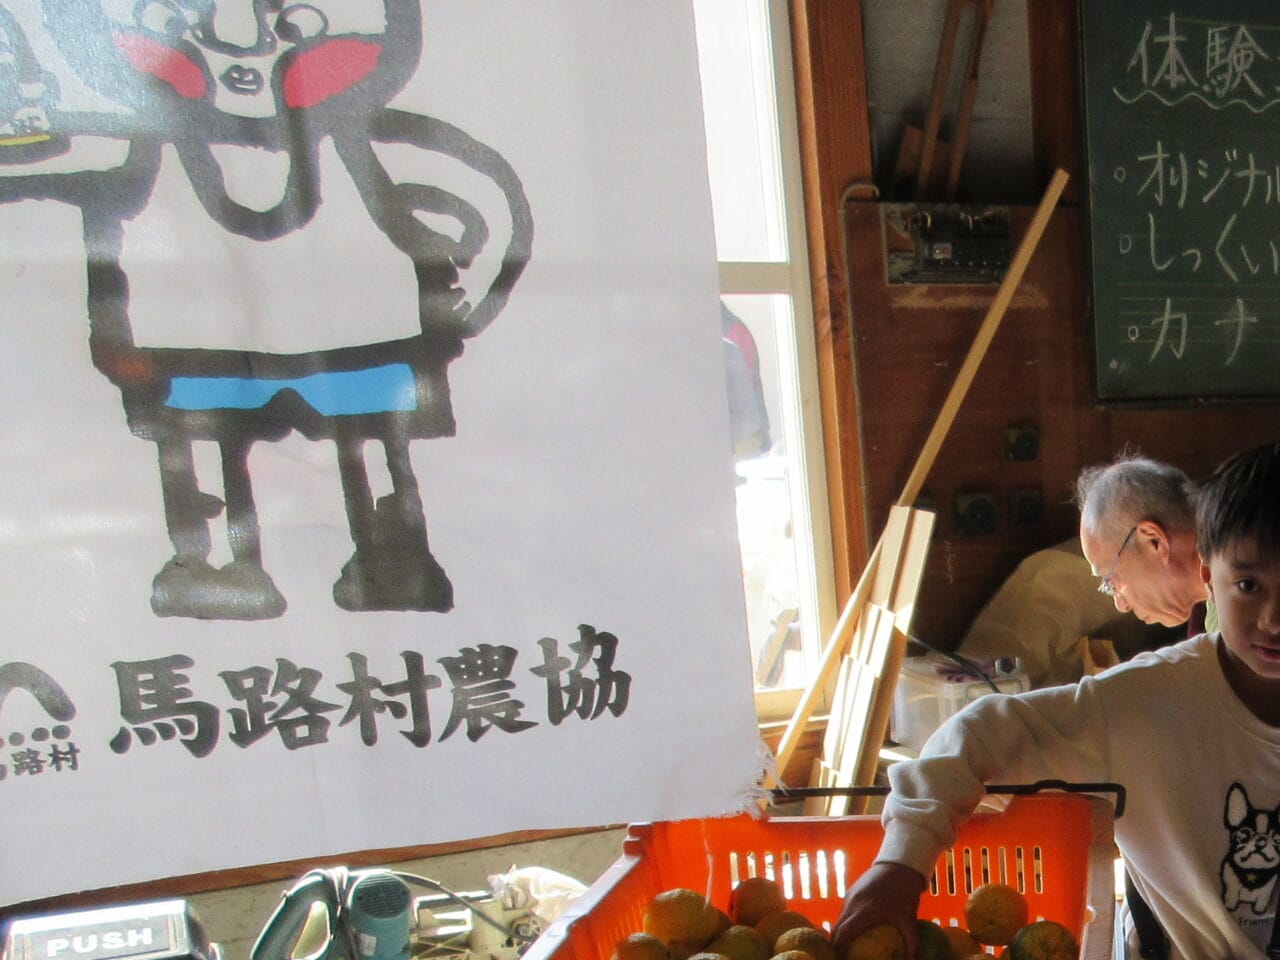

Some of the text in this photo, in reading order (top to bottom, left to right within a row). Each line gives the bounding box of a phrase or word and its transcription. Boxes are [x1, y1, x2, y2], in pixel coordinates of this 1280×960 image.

[109, 622, 633, 759] 馬路村農協
[0, 741, 81, 781] 路村
[46, 927, 153, 958] PUSH
